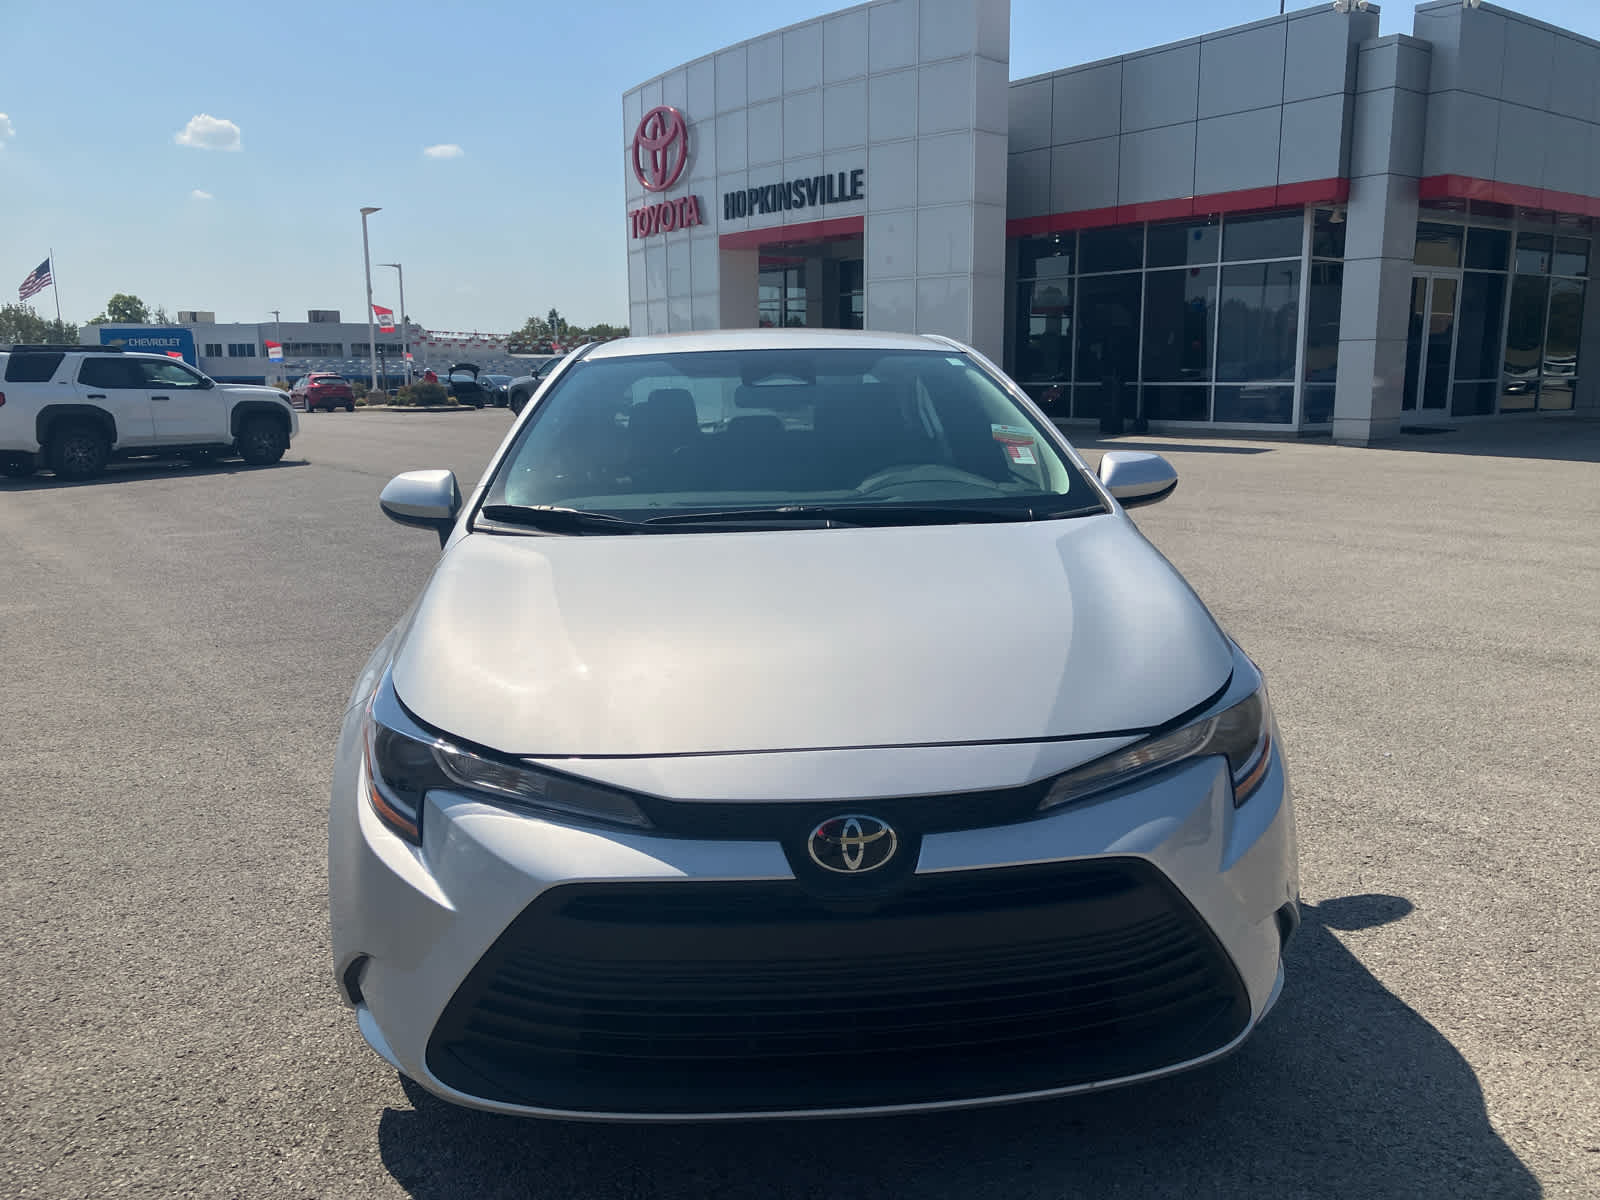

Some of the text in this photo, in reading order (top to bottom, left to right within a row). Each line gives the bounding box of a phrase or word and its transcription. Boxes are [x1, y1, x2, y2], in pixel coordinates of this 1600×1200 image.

[724, 169, 864, 220] HOPKINSVILLE
[629, 195, 702, 238] TOYOTA
[128, 338, 180, 347] CHEVROLET
